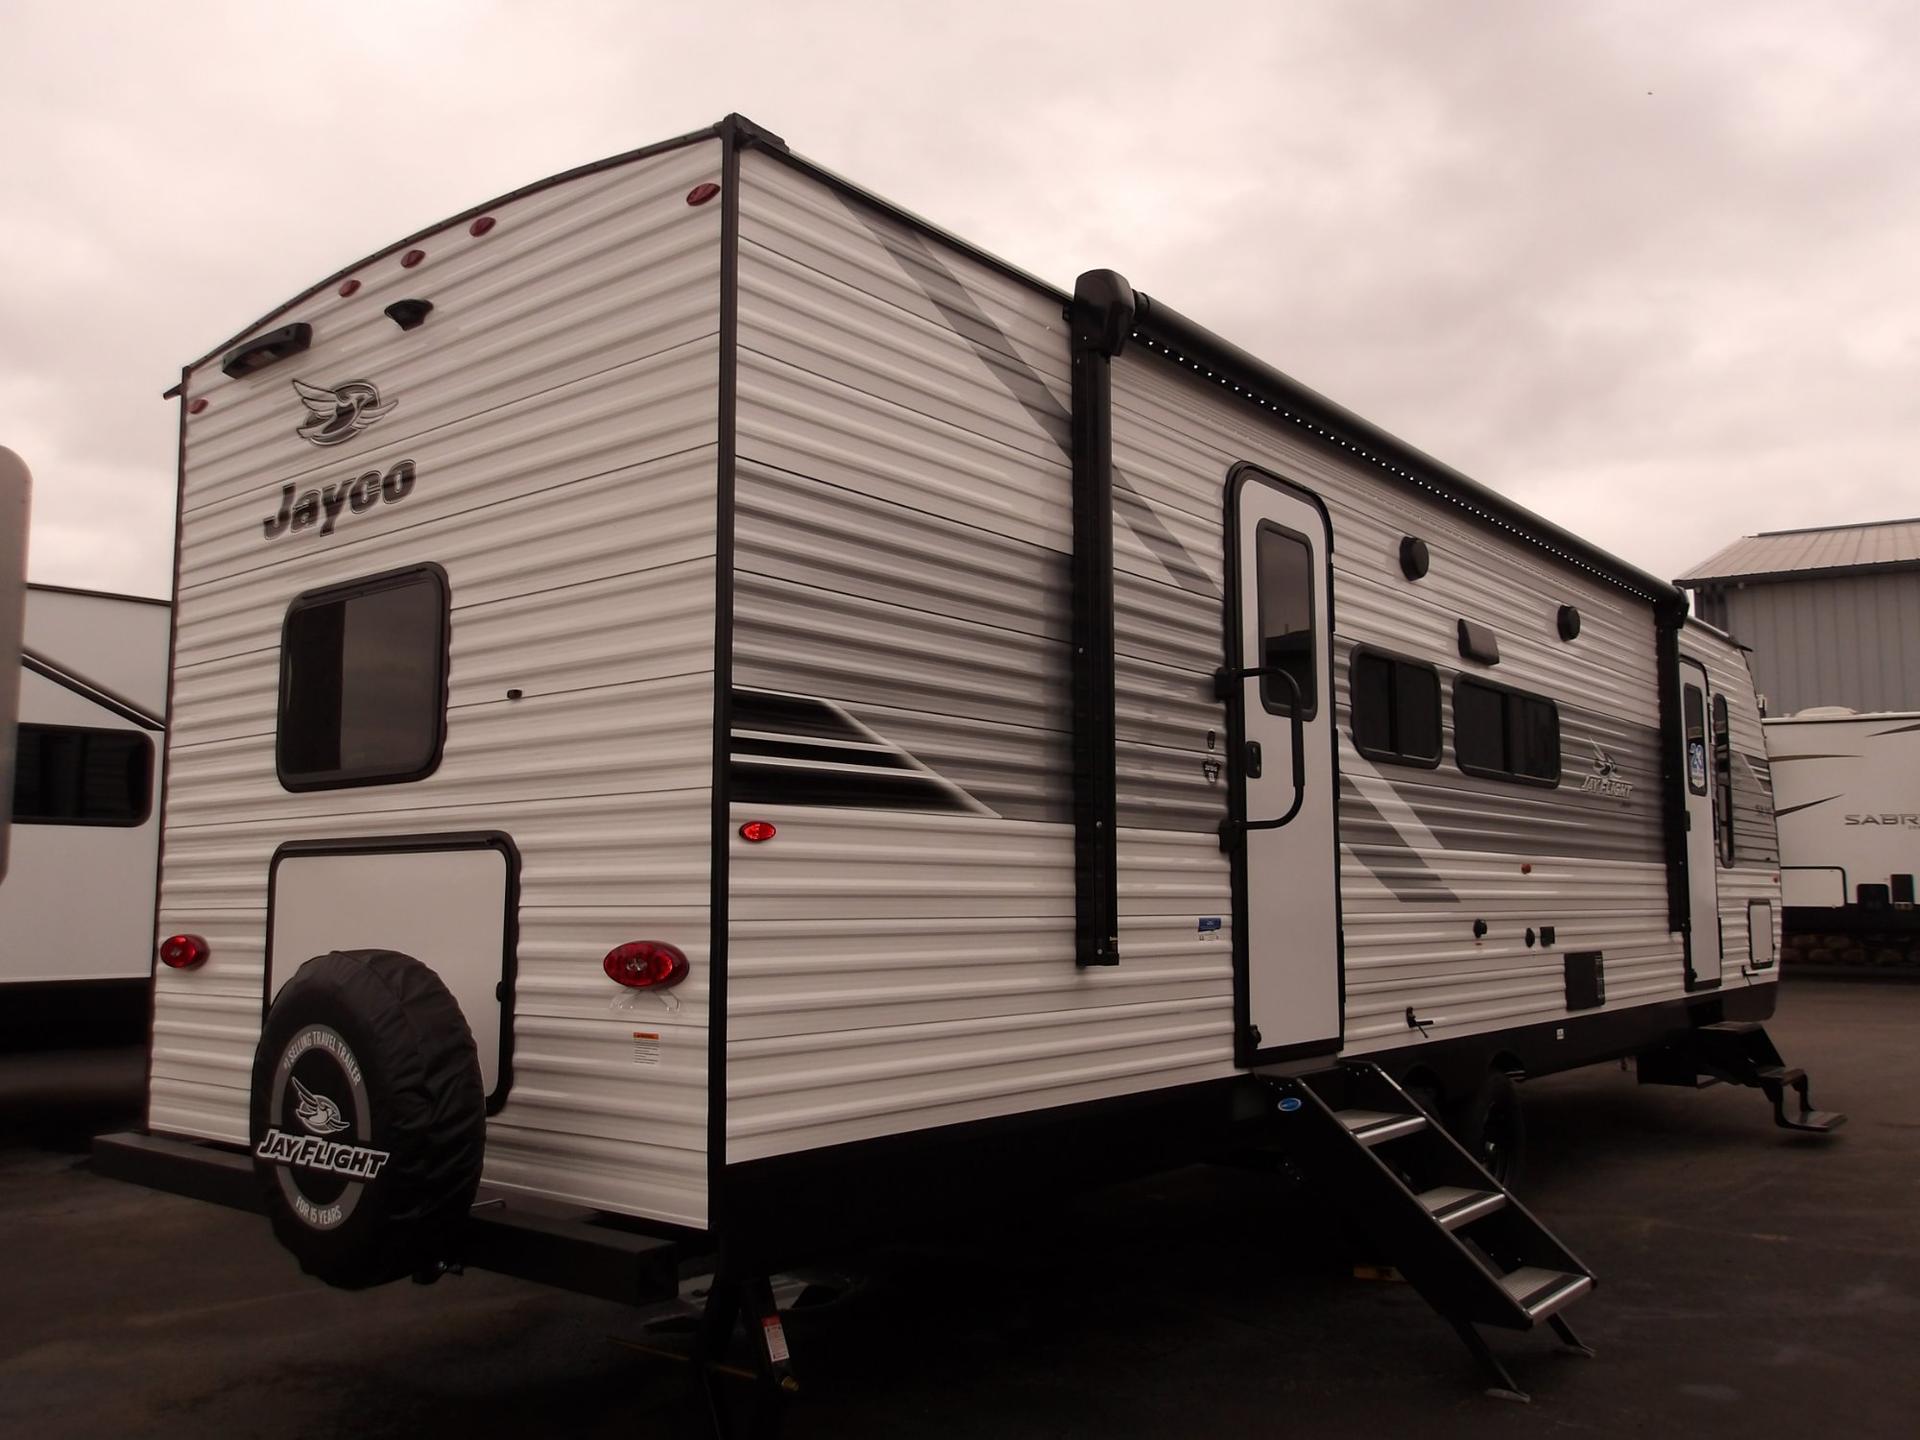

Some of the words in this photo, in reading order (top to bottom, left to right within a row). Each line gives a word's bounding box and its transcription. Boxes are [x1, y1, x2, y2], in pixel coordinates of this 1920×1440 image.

[263, 459, 416, 540] Jayco
[287, 1032, 312, 1063] SELLING
[312, 1031, 336, 1052] TRAVEL
[337, 1041, 361, 1086] TRAILER
[296, 1196, 310, 1217] FOR
[318, 1204, 342, 1225] YEARS
